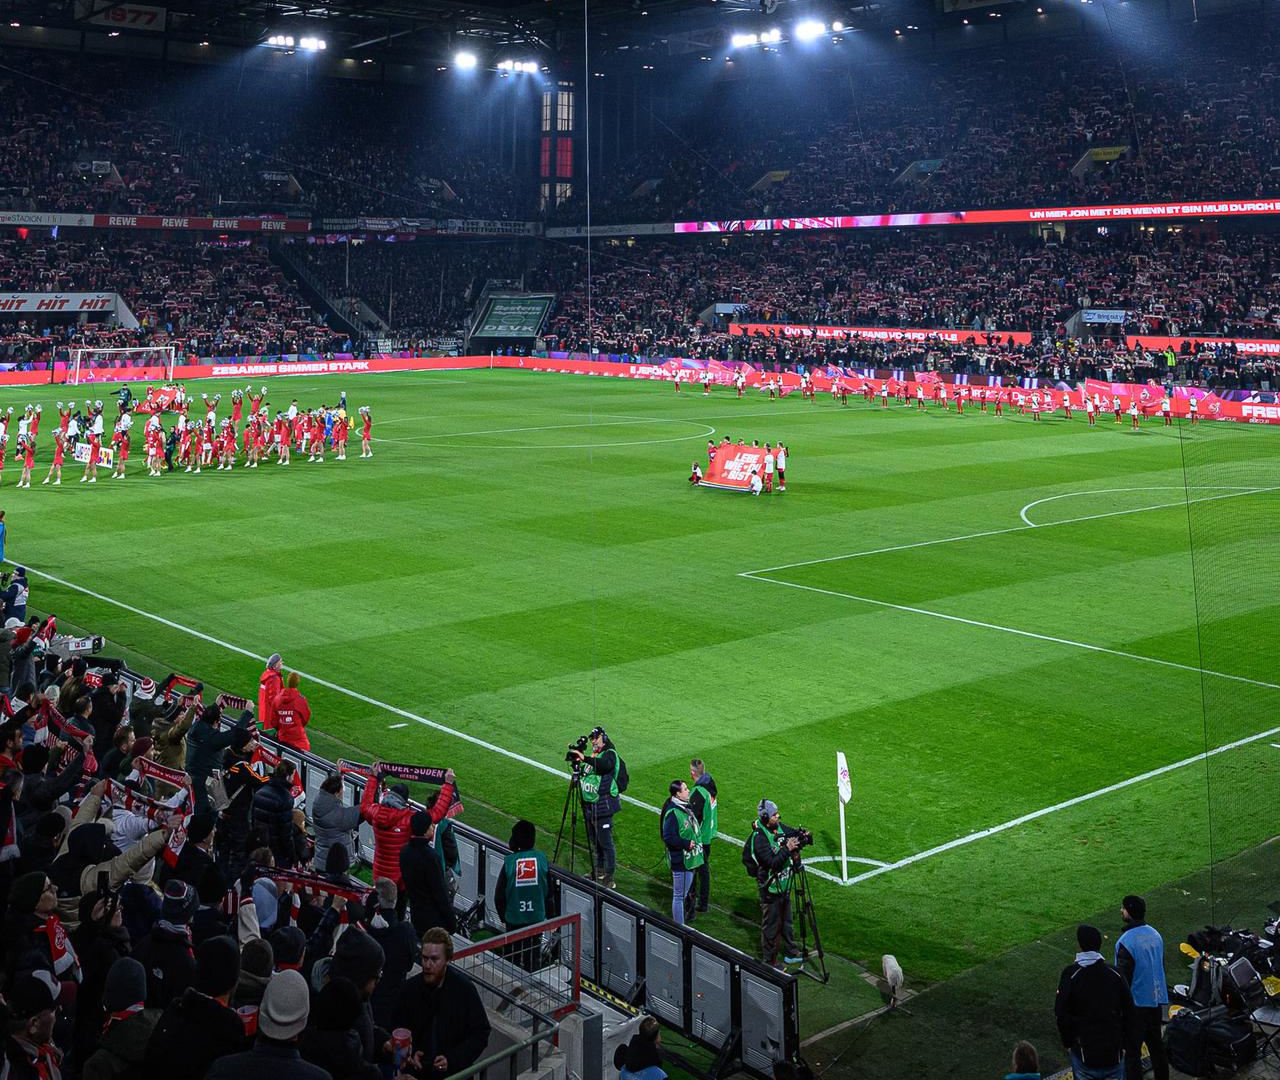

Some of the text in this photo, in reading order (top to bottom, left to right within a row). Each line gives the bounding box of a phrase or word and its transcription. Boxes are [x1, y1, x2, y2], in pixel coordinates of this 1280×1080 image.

[1029, 211, 1045, 219] UN
[1045, 210, 1068, 219] MER
[1068, 209, 1089, 218] JON
[1090, 208, 1112, 217] MET
[1112, 207, 1132, 216] DIR
[1132, 206, 1165, 216] WENN
[1166, 205, 1181, 214] ET
[1181, 204, 1202, 214] SIN
[1229, 202, 1274, 212] DURCH
[108, 216, 138, 227] REWE
[161, 217, 190, 228] REWE
[212, 219, 240, 229] REWE
[261, 220, 287, 231] REWE
[37, 299, 70, 311] HIT
[79, 298, 113, 311] HIT
[212, 361, 370, 376] ZESAMME SIMMER STARK
[734, 452, 761, 464] LEBE
[724, 460, 745, 472] WIE
[727, 470, 753, 482] BIST
[519, 900, 535, 912] 31
